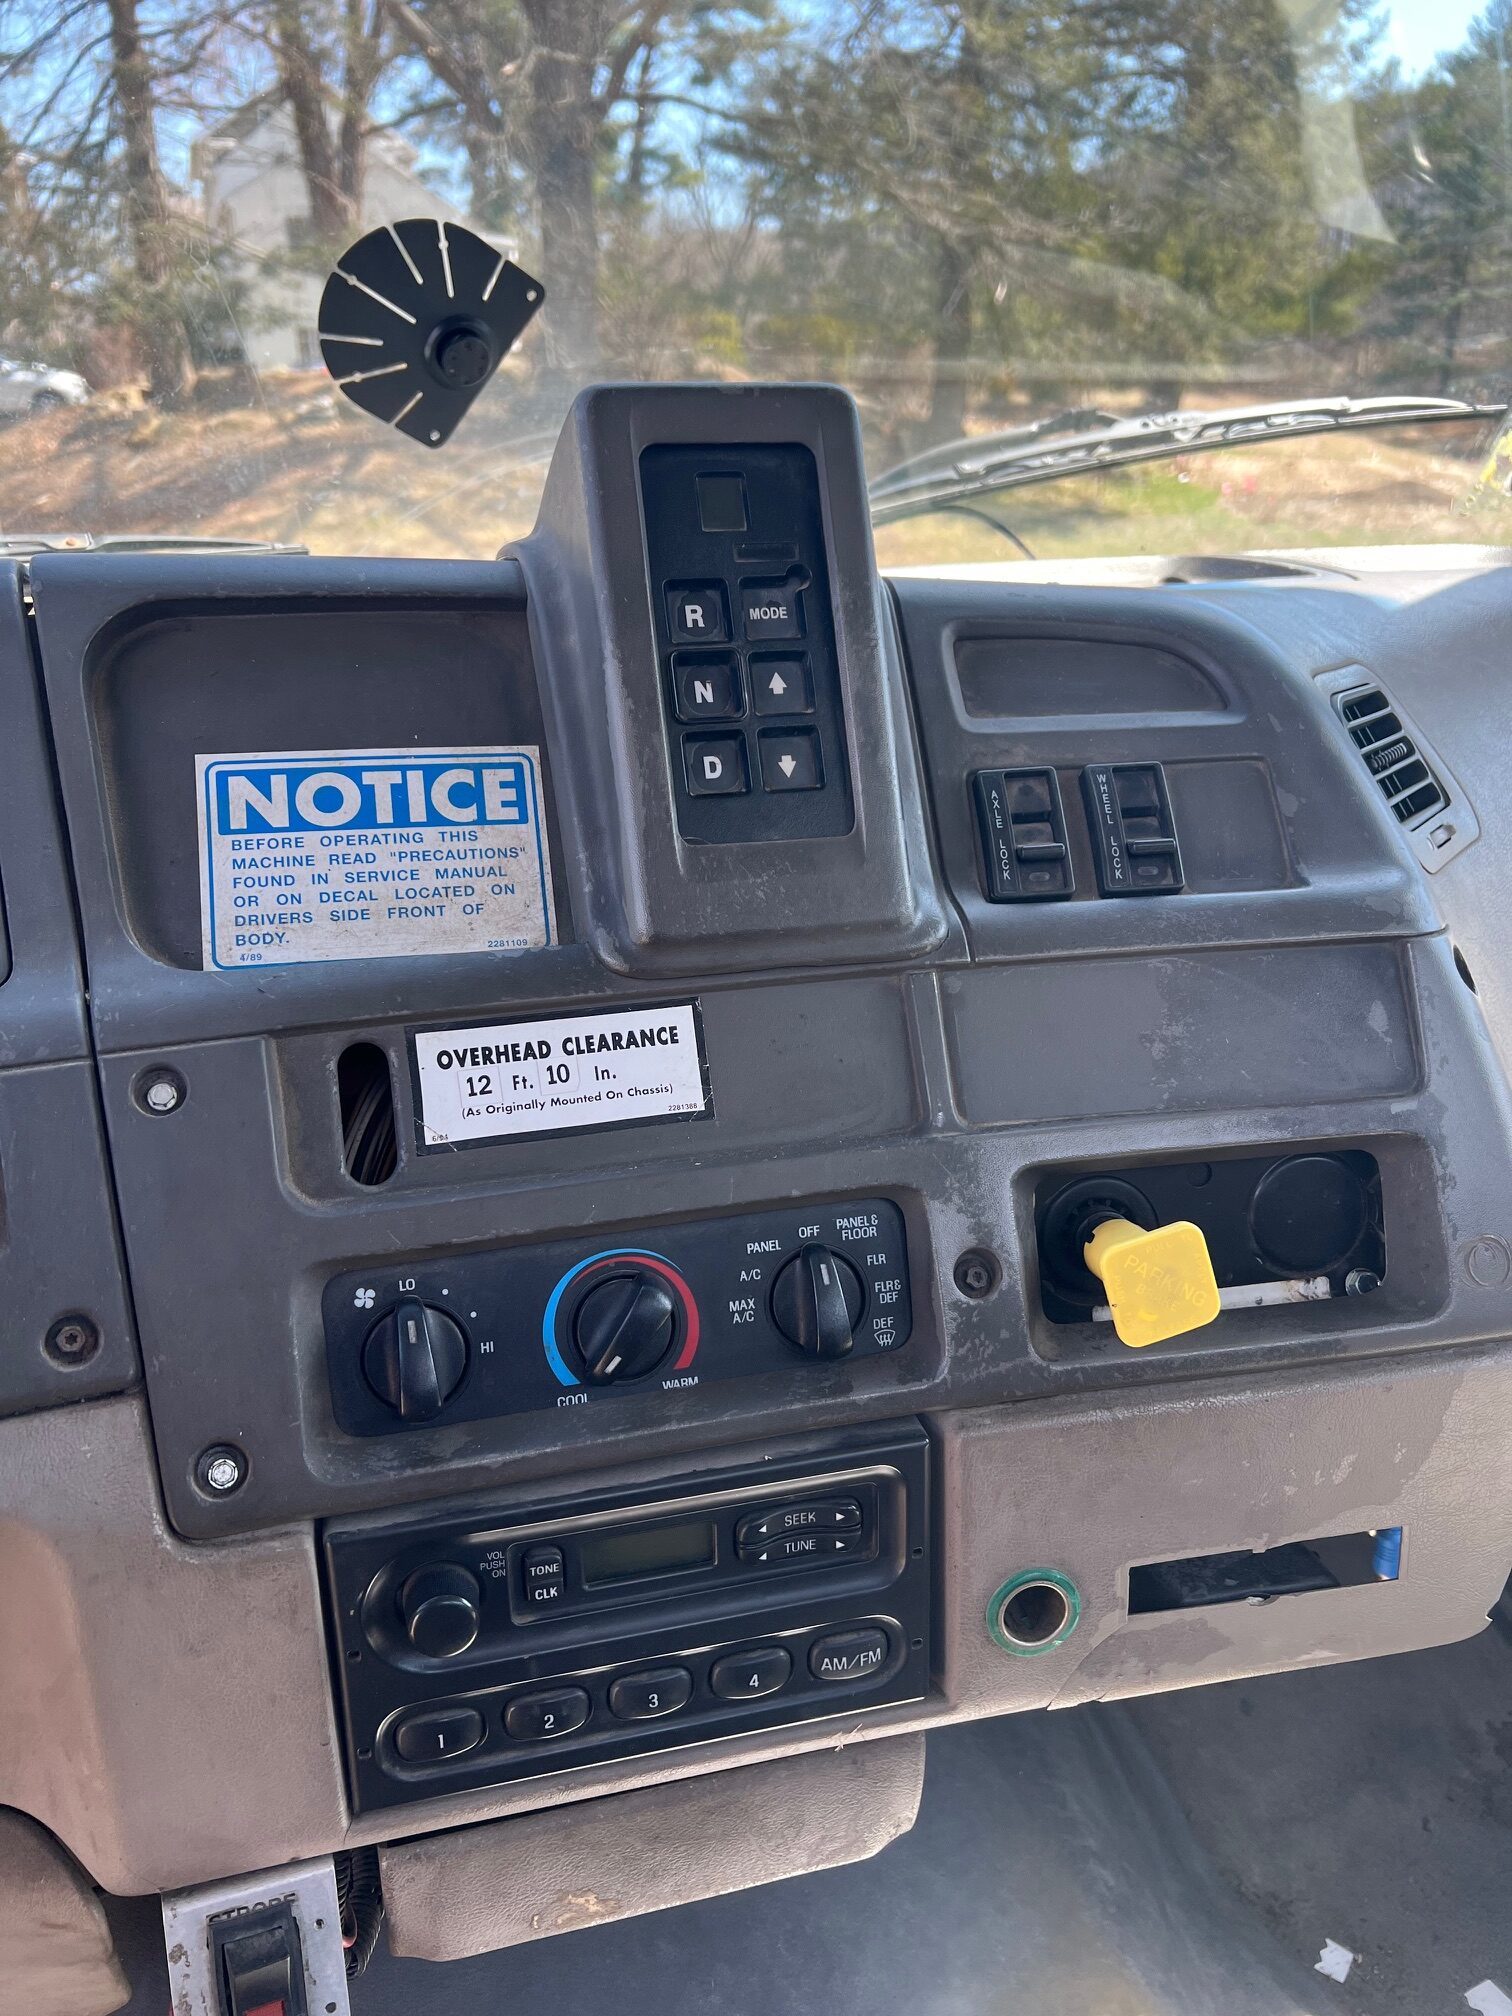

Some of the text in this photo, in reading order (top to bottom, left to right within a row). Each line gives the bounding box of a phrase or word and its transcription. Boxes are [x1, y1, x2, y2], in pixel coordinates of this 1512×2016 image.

[685, 605, 705, 628] R
[749, 606, 788, 621] MODE
[694, 680, 714, 704] N
[703, 755, 722, 780] D
[228, 768, 520, 830] NOTICE
[991, 789, 1011, 880] AXLE LOCK
[1096, 774, 1123, 880] WHEEL LOCK
[232, 830, 478, 851] BEFORE OPERATING THIS
[232, 847, 526, 870] MACHINE READ "PRECAUTIONS"
[233, 866, 507, 889] FOUND IN SERVICE MANUAL
[234, 884, 516, 908] OR ON DECAL LOCATED ON
[235, 903, 485, 927] DRIVERS SIDE FRONT OF
[235, 932, 289, 947] BODY.
[487, 938, 528, 948] 2281109
[239, 953, 262, 963] 4/89
[436, 1025, 680, 1070] OVERHEAD CLEARANCE
[466, 1063, 617, 1097] 12 Ft. 10 In.
[461, 1083, 673, 1119] (As Originally Mounted On Chassis)
[836, 1215, 870, 1230] PANEL
[798, 1225, 820, 1238] OFF
[842, 1227, 877, 1241] FLOOR
[747, 1240, 781, 1254] PANEL
[867, 1253, 886, 1265] FLR
[740, 1269, 761, 1282] A/C
[1124, 1255, 1206, 1306] PARKING
[399, 1278, 415, 1292] LO
[729, 1298, 755, 1313] MAX
[879, 1292, 899, 1304] DEF
[733, 1310, 754, 1324] A/C
[873, 1316, 894, 1330] DEF
[480, 1341, 494, 1354] HI
[662, 1376, 699, 1390] WARM
[784, 1511, 816, 1527] SEEK
[784, 1539, 817, 1554] TUNE
[487, 1551, 505, 1560] VOL
[480, 1560, 505, 1571] PUSH
[529, 1562, 560, 1576] TONE
[492, 1569, 506, 1578] ON
[534, 1586, 558, 1600] CLK
[820, 1647, 882, 1672] AM/FM
[749, 1673, 760, 1689] 4
[648, 1692, 659, 1709] 3
[544, 1713, 555, 1730] 2
[437, 1733, 445, 1749] 1
